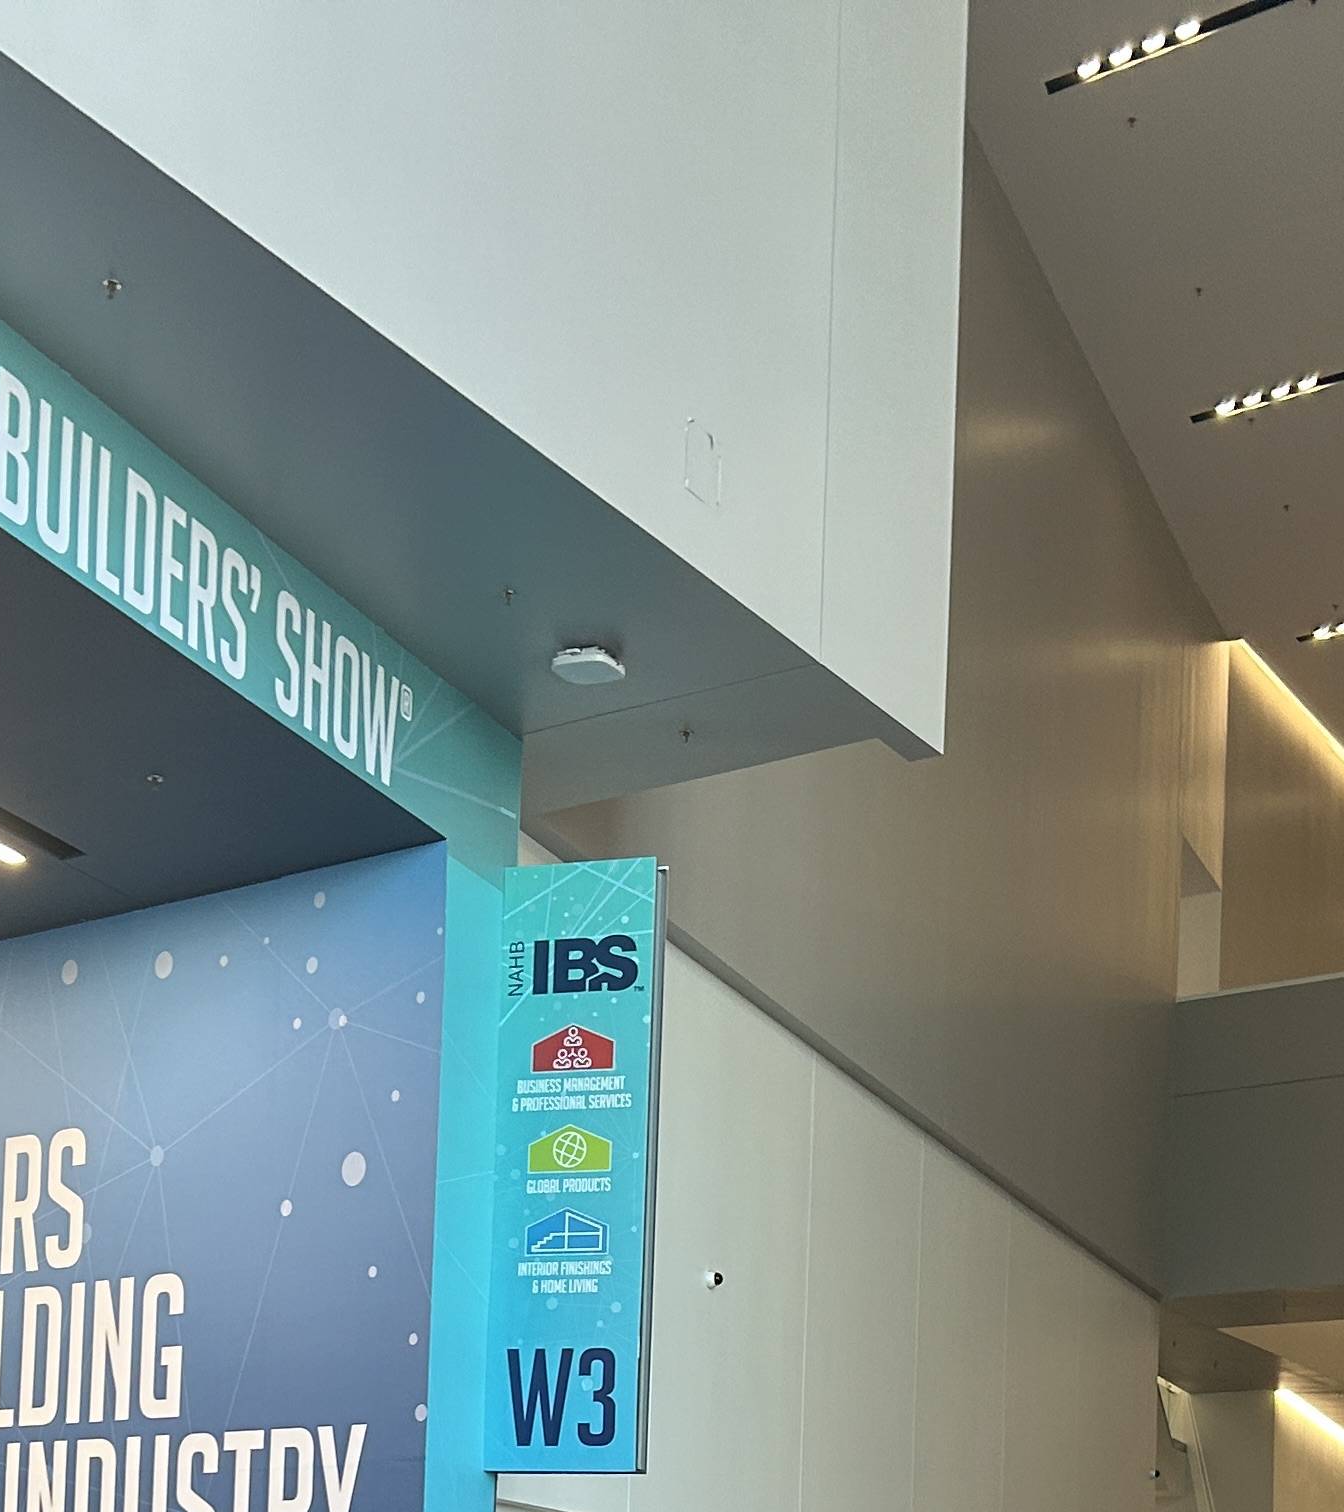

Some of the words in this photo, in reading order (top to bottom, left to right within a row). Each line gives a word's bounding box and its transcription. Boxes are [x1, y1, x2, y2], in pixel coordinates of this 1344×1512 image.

[508, 941, 525, 996] NAHB
[517, 1078, 562, 1095] BUSINESS
[563, 1075, 626, 1094] MANAGEMENT
[520, 1095, 587, 1112] PROFESSIONAL
[589, 1093, 632, 1109] SERVICES
[526, 1179, 561, 1194] GLOBAL
[562, 1177, 612, 1193] PRODUCTS
[518, 1262, 559, 1276] INTERIOR
[560, 1260, 612, 1275] FINISHINGS
[540, 1279, 567, 1293] HOME
[568, 1278, 599, 1293] LIVING
[506, 1347, 617, 1449] W3
